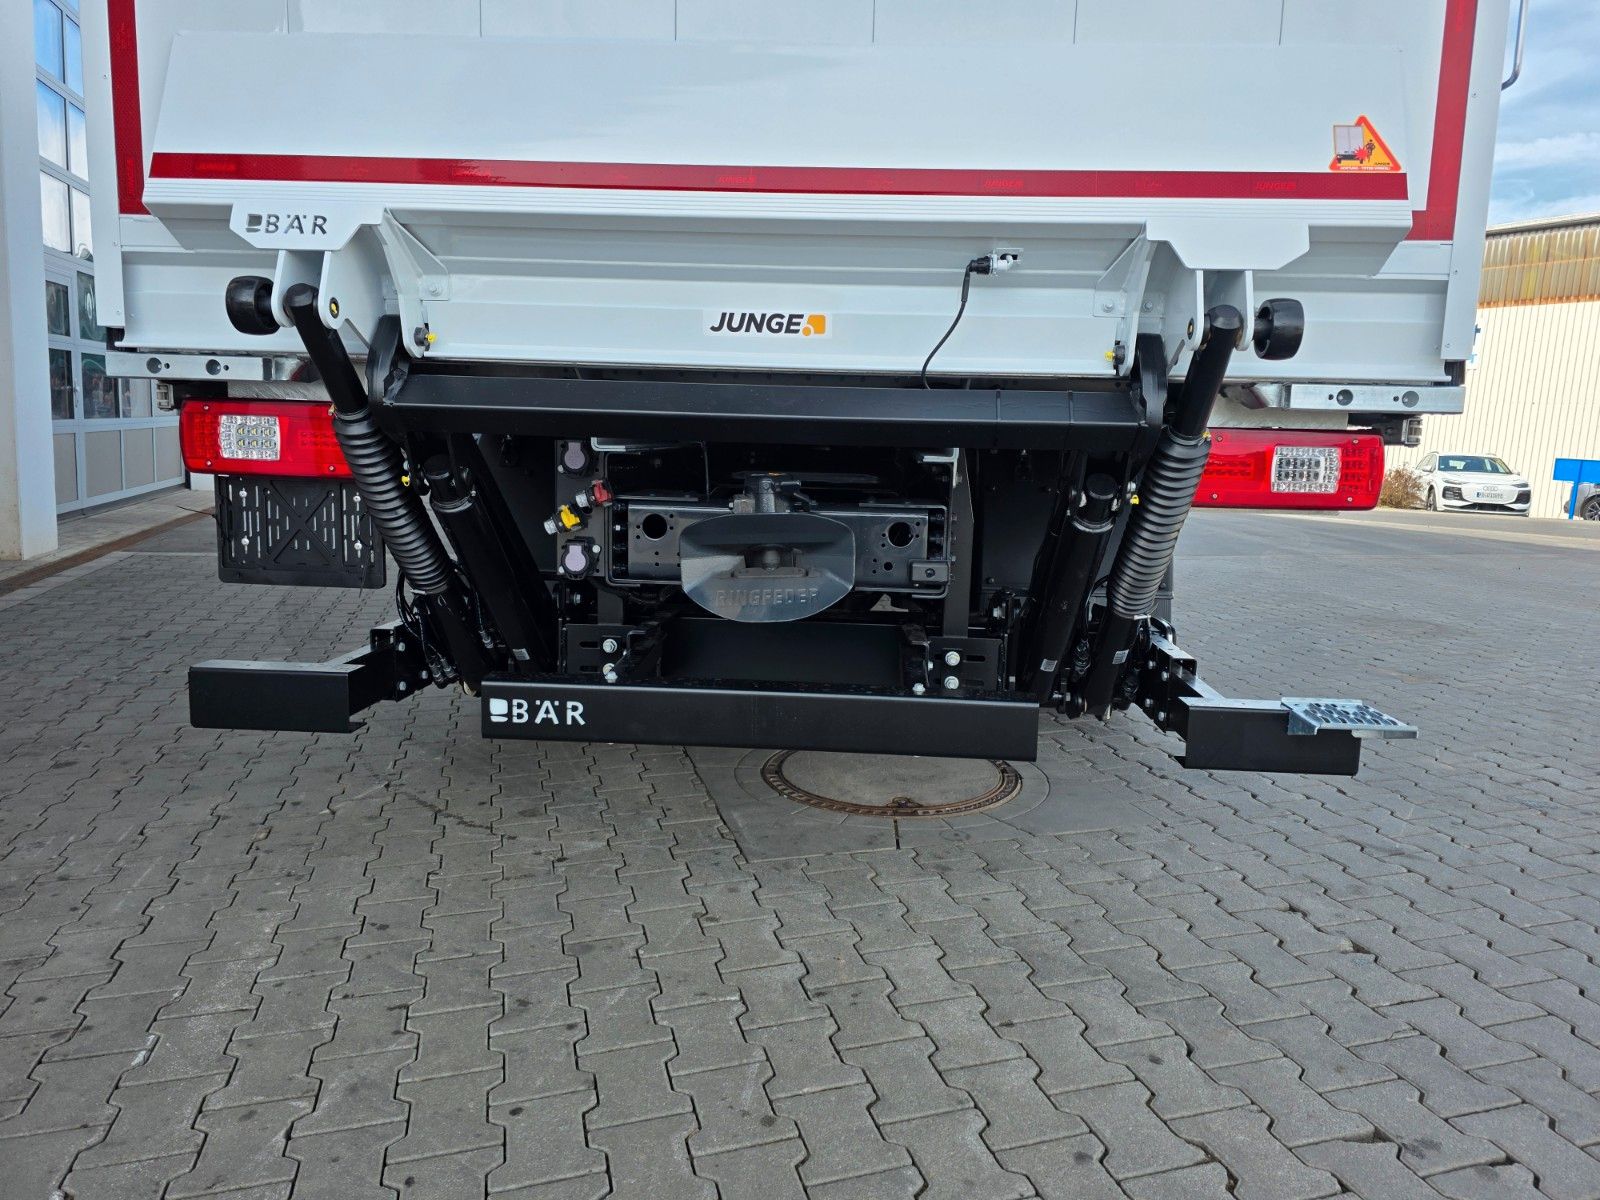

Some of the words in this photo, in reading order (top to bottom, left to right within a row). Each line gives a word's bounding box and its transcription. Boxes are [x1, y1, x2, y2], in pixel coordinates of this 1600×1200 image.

[265, 213, 328, 235] BÄR
[709, 312, 804, 334] JUNGE
[511, 698, 586, 726] BÄR
